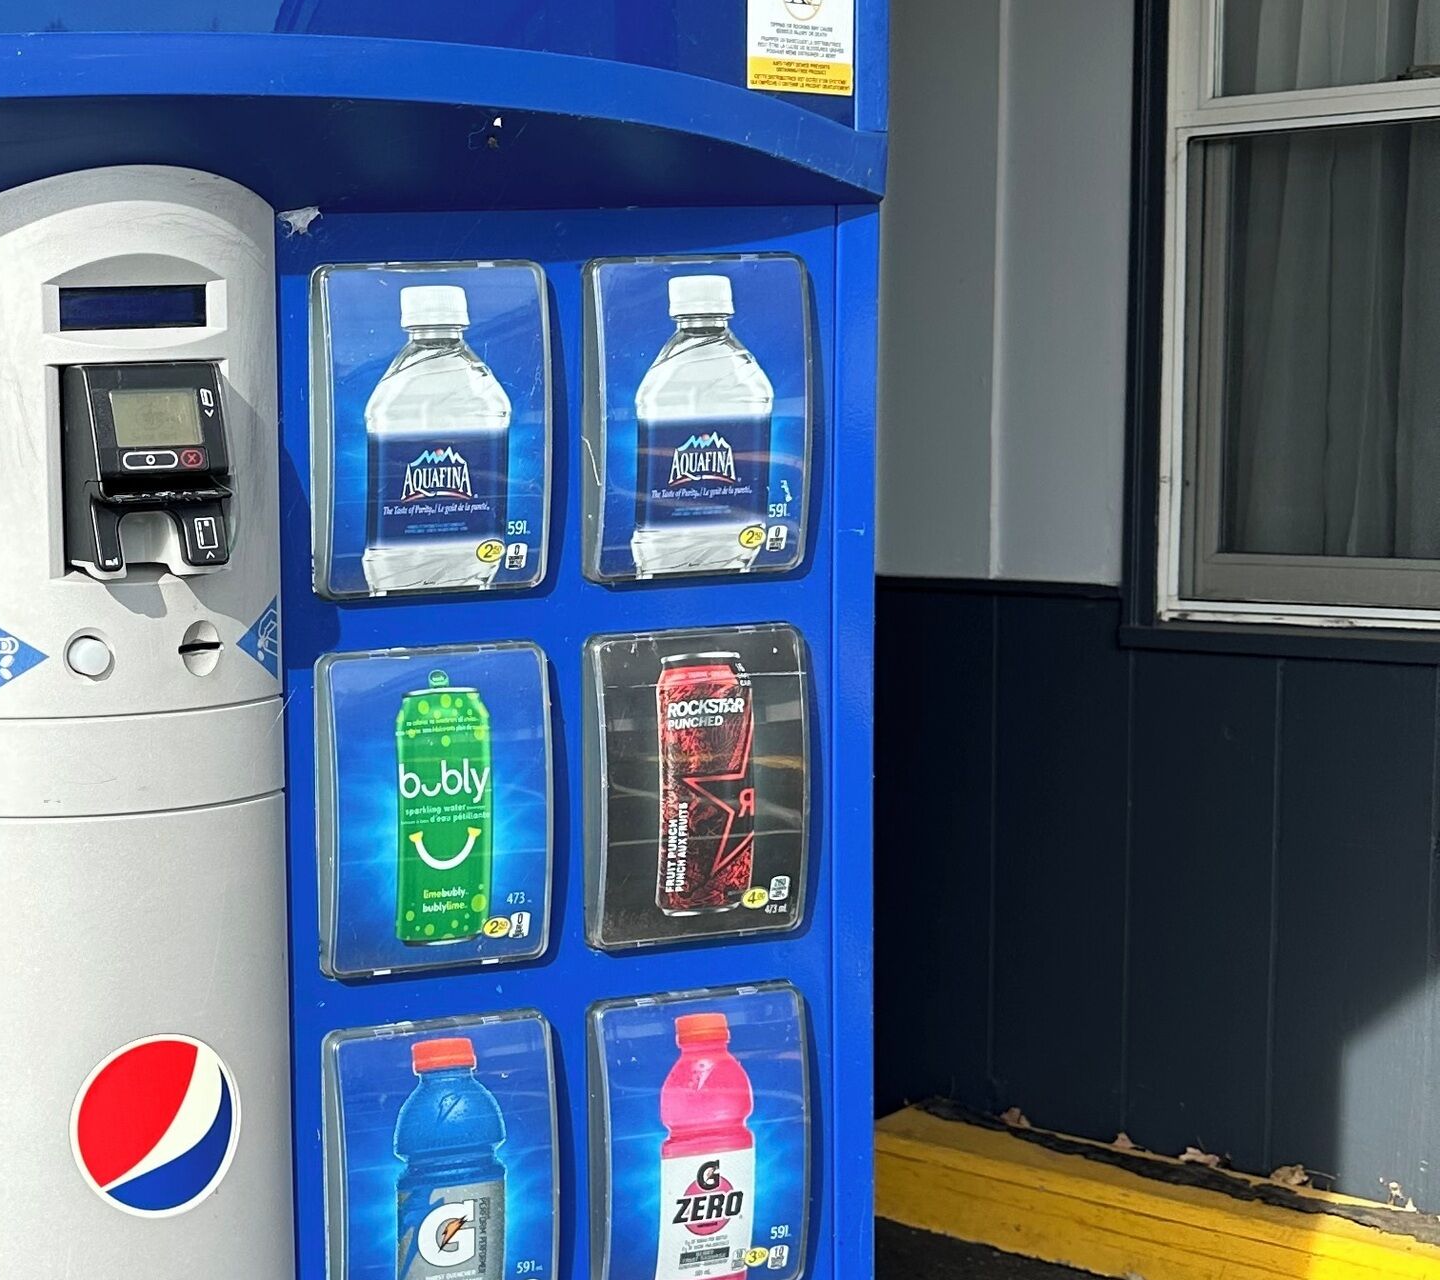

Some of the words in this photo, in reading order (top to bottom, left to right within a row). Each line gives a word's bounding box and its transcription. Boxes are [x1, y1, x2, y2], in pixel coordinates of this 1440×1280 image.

[401, 462, 472, 501] AQUAFINA
[668, 448, 736, 484] AQUAFINA
[508, 520, 527, 535] 591
[667, 697, 745, 718] ROCKSTAR
[668, 715, 724, 731] PUNCHED
[399, 758, 490, 803] bubly
[405, 805, 442, 816] sparkling
[443, 804, 466, 812] water
[667, 819, 678, 858] PUNCH
[678, 837, 688, 858] AUX
[665, 860, 676, 892] FRUIT
[675, 860, 686, 892] PUNCH
[506, 892, 526, 904] 473
[697, 1159, 720, 1190] G
[672, 1191, 744, 1224] ZERO
[418, 1199, 476, 1268] G
[770, 1225, 789, 1239] 591
[516, 1260, 536, 1274] 591
